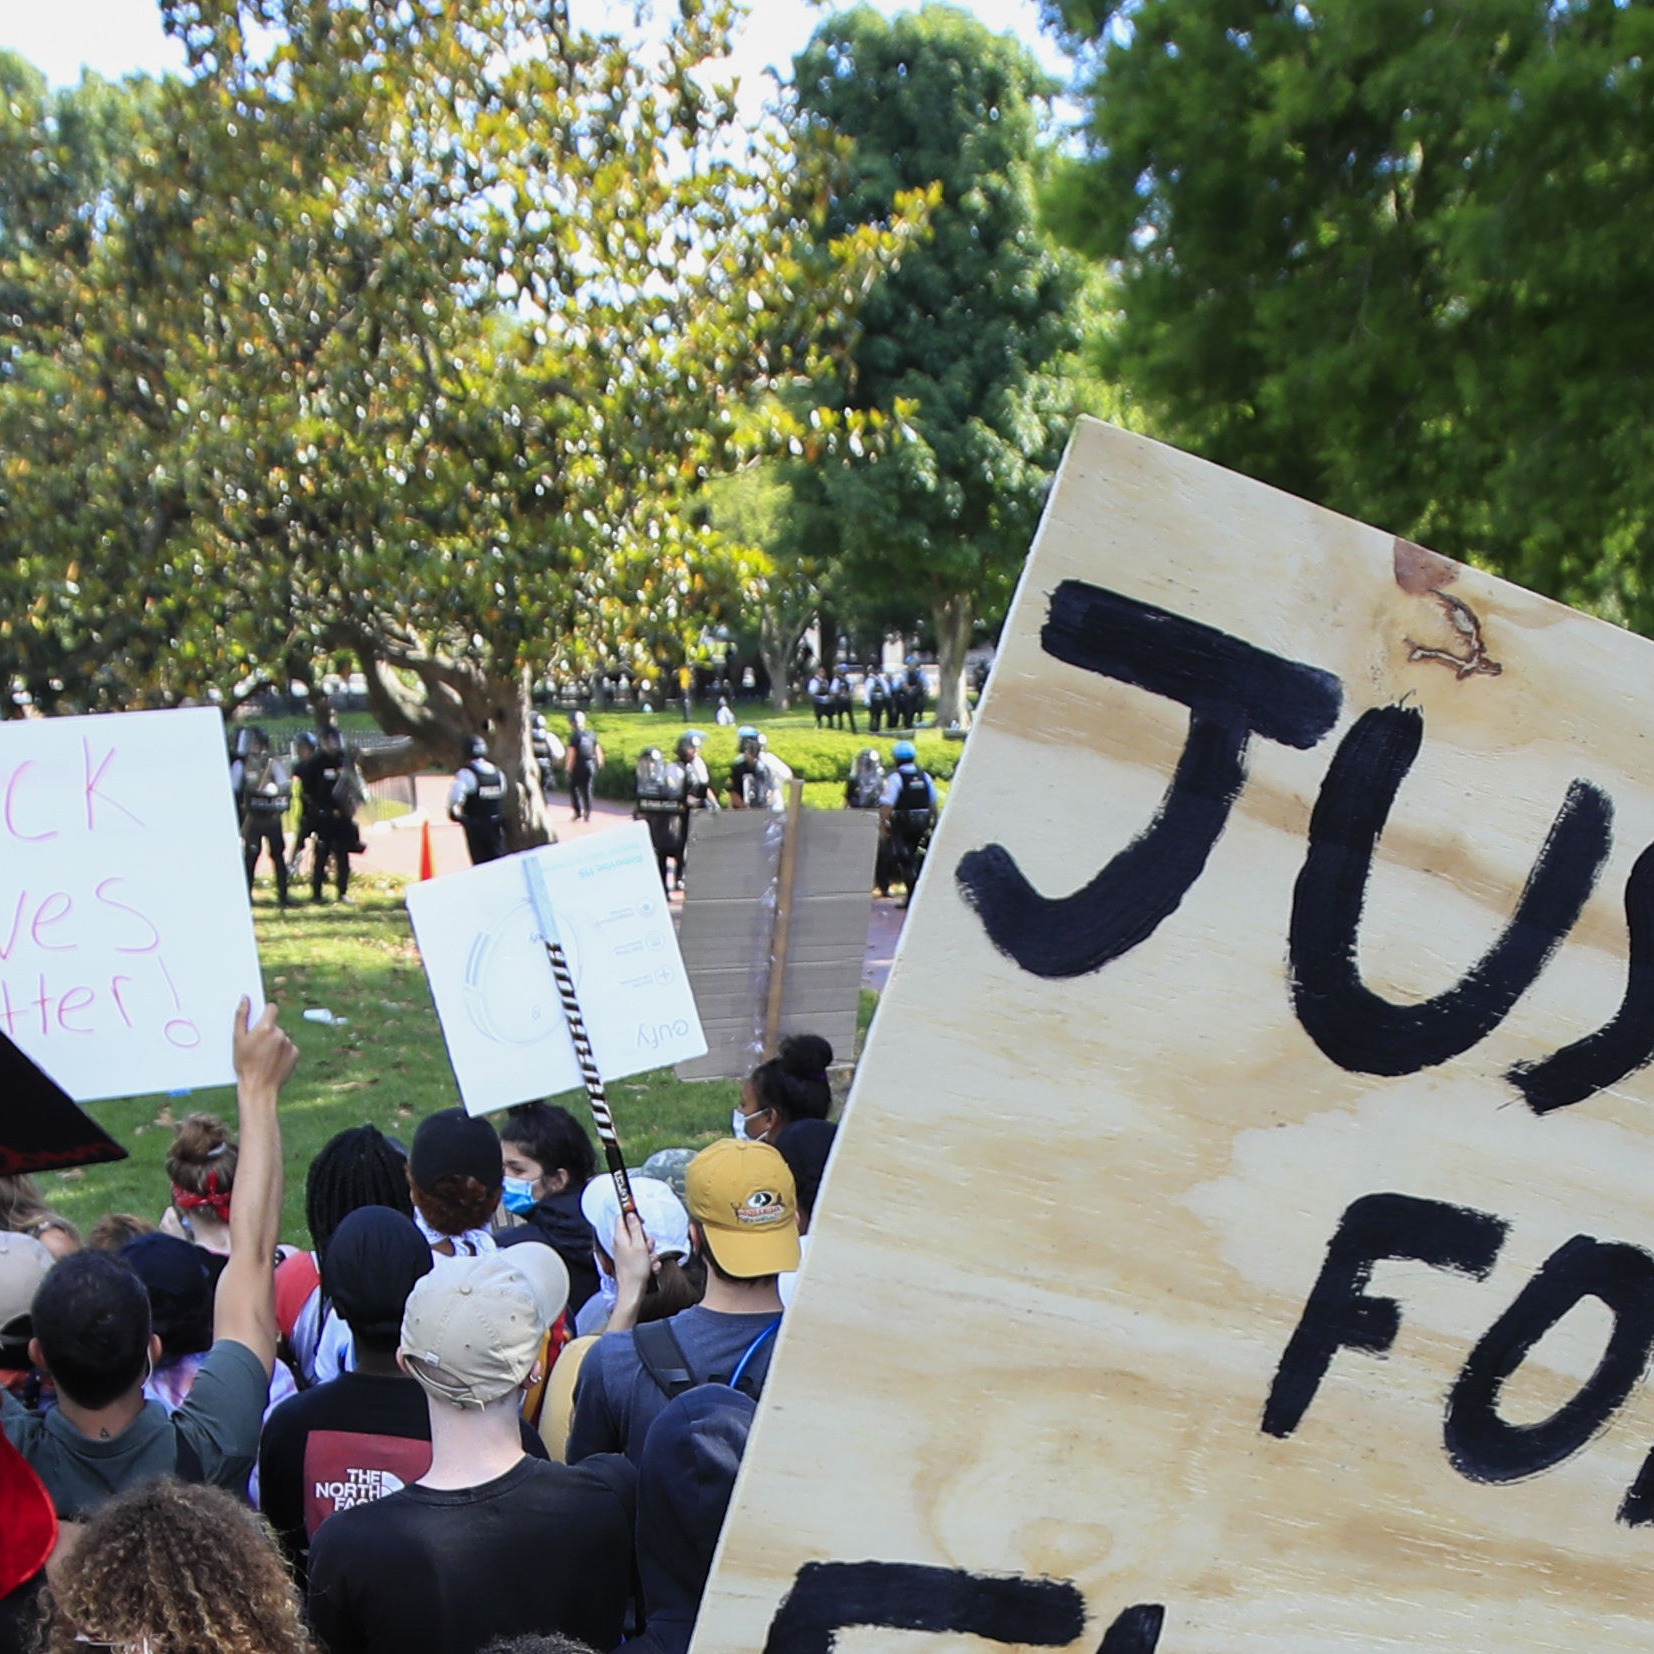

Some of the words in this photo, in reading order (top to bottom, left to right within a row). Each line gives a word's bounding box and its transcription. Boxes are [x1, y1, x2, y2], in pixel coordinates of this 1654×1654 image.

[637, 1018, 690, 1050] eufy
[346, 1468, 381, 1486] THE
[315, 1482, 381, 1499] NORTH
